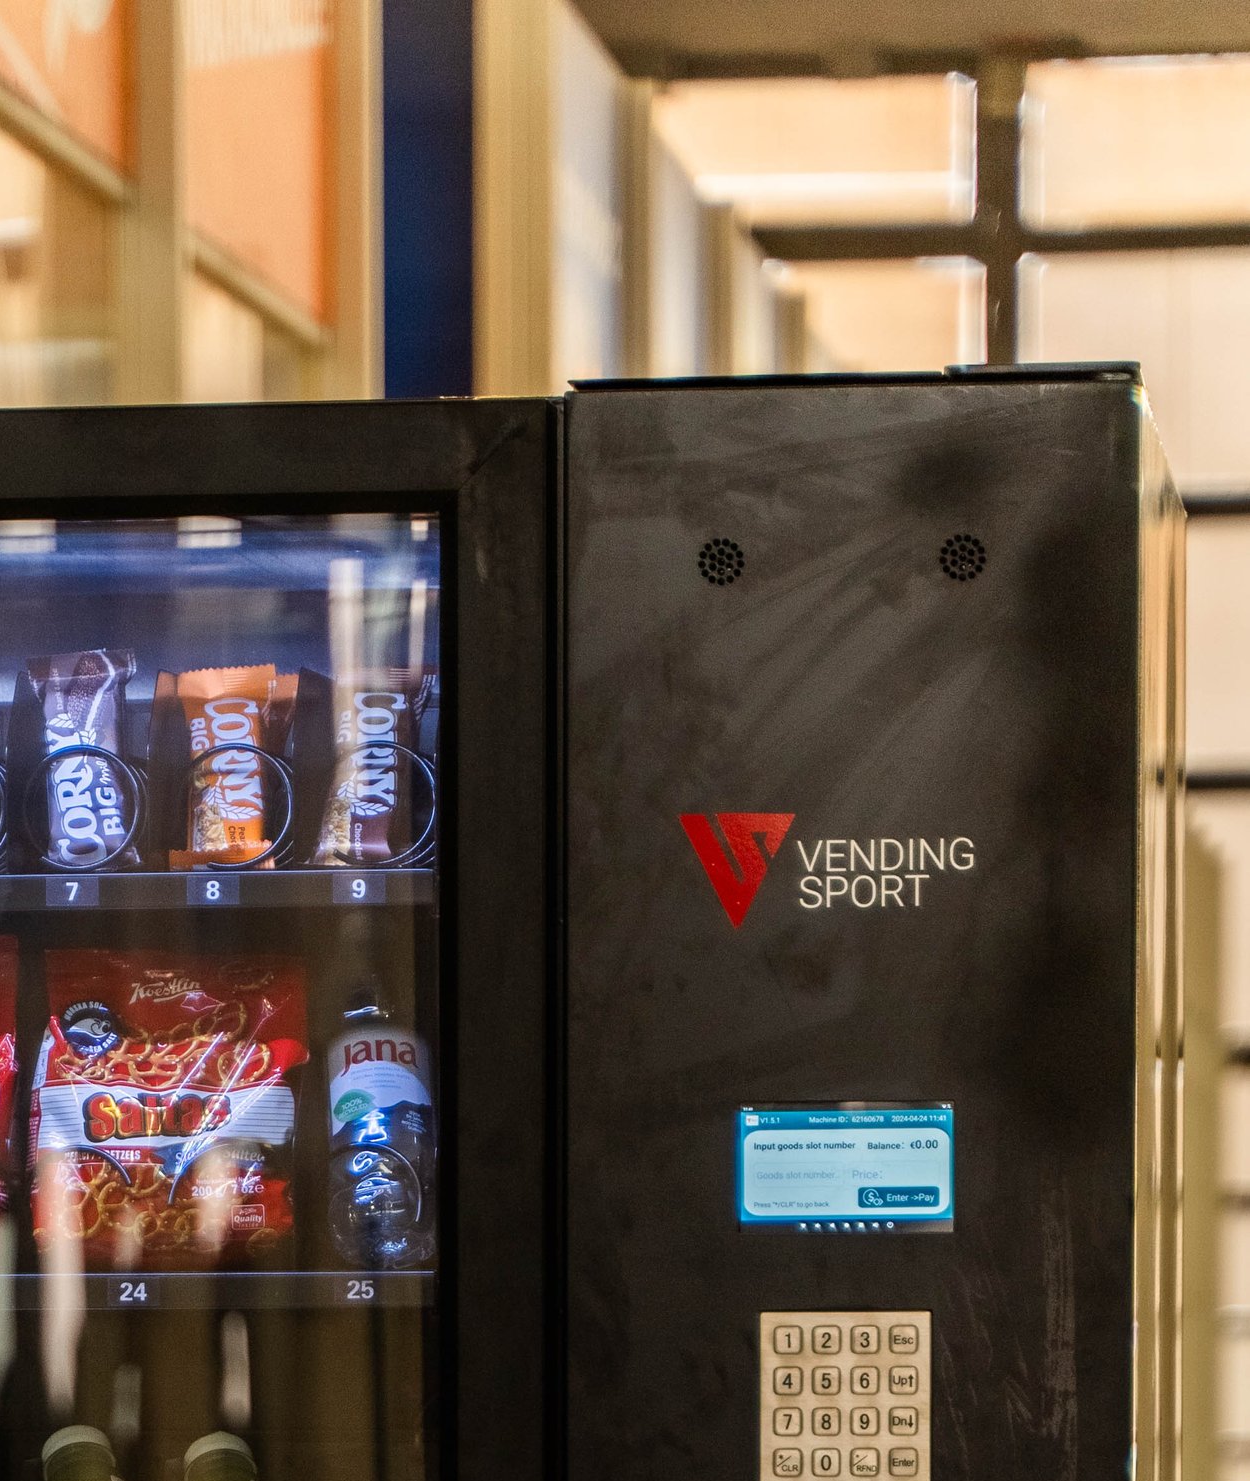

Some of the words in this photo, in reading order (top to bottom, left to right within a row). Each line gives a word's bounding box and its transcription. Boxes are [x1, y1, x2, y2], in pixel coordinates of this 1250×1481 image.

[189, 717, 210, 751] BIG
[204, 697, 264, 811] CORNY
[353, 691, 407, 808] CORNY
[46, 729, 108, 866] CORNY
[95, 786, 126, 837] BIG
[797, 837, 975, 872] VENDING
[66, 882, 78, 901] 7
[206, 881, 220, 900] 8
[351, 879, 366, 898] 9
[799, 874, 930, 909] SPORT
[341, 1039, 419, 1077] jana
[754, 1142, 775, 1151] Input
[777, 1142, 803, 1151] goods
[806, 1141, 821, 1149] slot
[824, 1141, 856, 1149] number
[868, 1142, 905, 1150] Balance:
[910, 1139, 939, 1149] €0.00
[756, 1171, 783, 1180] Goods
[786, 1170, 801, 1179] slot
[886, 1194, 908, 1202] Enter
[234, 1214, 263, 1224] Quality
[120, 1282, 147, 1301] 24
[346, 1280, 374, 1300] 25
[785, 1333, 791, 1348] 1
[821, 1332, 832, 1348] 2
[860, 1332, 870, 1348] 3
[893, 1335, 914, 1345] Esc
[782, 1373, 793, 1389] 4
[821, 1373, 832, 1389] 5
[860, 1373, 870, 1389] 6
[783, 1414, 792, 1430] 7
[821, 1413, 832, 1430] 8
[860, 1413, 870, 1429] 9
[821, 1455, 832, 1470] 0
[892, 1458, 914, 1466] Enter
